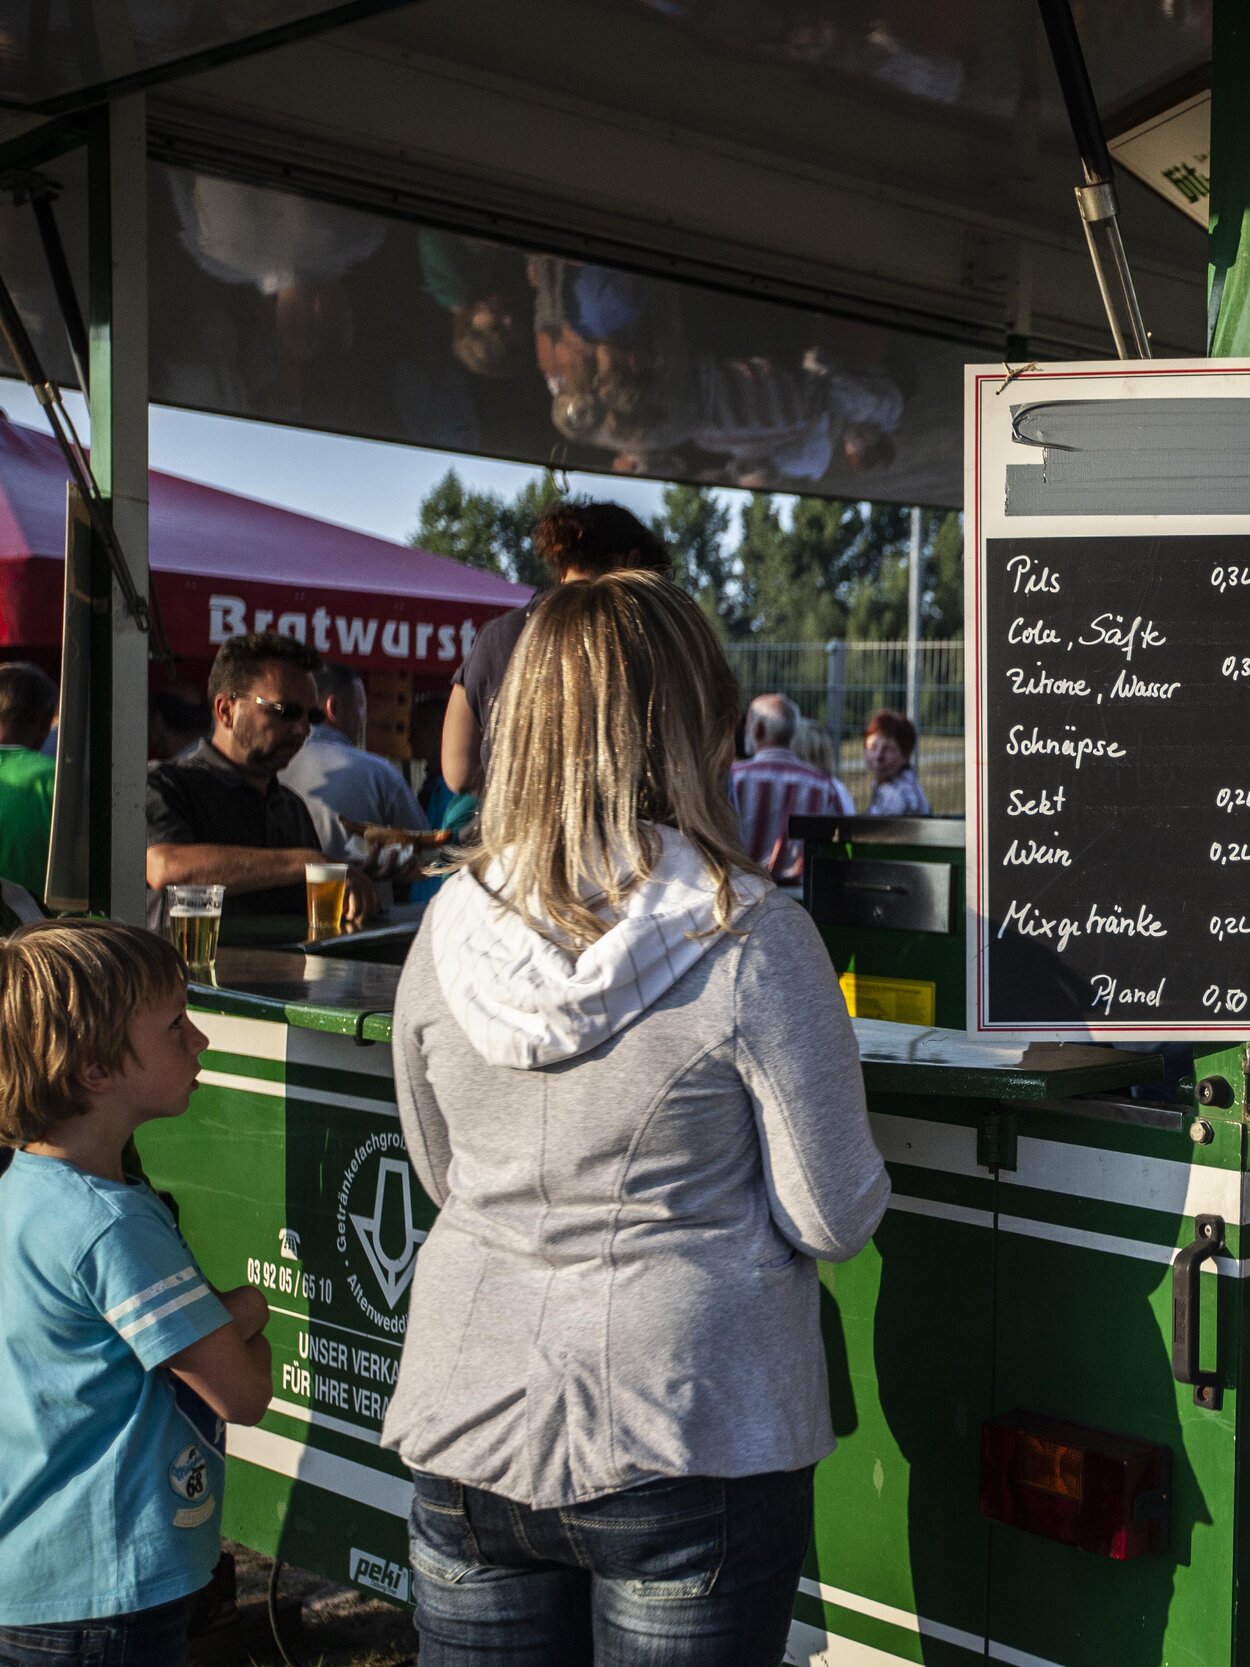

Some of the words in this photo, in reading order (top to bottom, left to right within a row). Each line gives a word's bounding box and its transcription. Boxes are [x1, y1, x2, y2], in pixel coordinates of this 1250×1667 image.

[1006, 554, 1060, 594] Pils
[1109, 669, 1182, 700] Wasser
[1005, 724, 1128, 770] Schnäpse
[1006, 785, 1067, 816] Sekt
[1002, 830, 1073, 867] Wein
[997, 899, 1168, 953] Mixgetränke
[1090, 974, 1167, 1016] Pfand
[1202, 984, 1248, 1014] 0,50
[247, 1257, 261, 1285] 03
[262, 1261, 277, 1289] 92
[278, 1265, 293, 1294] 05
[302, 1272, 316, 1300] 65
[319, 1276, 333, 1305] 10
[298, 1331, 348, 1372] UNSER
[282, 1359, 311, 1398] FÜR
[314, 1373, 349, 1410] IHRE
